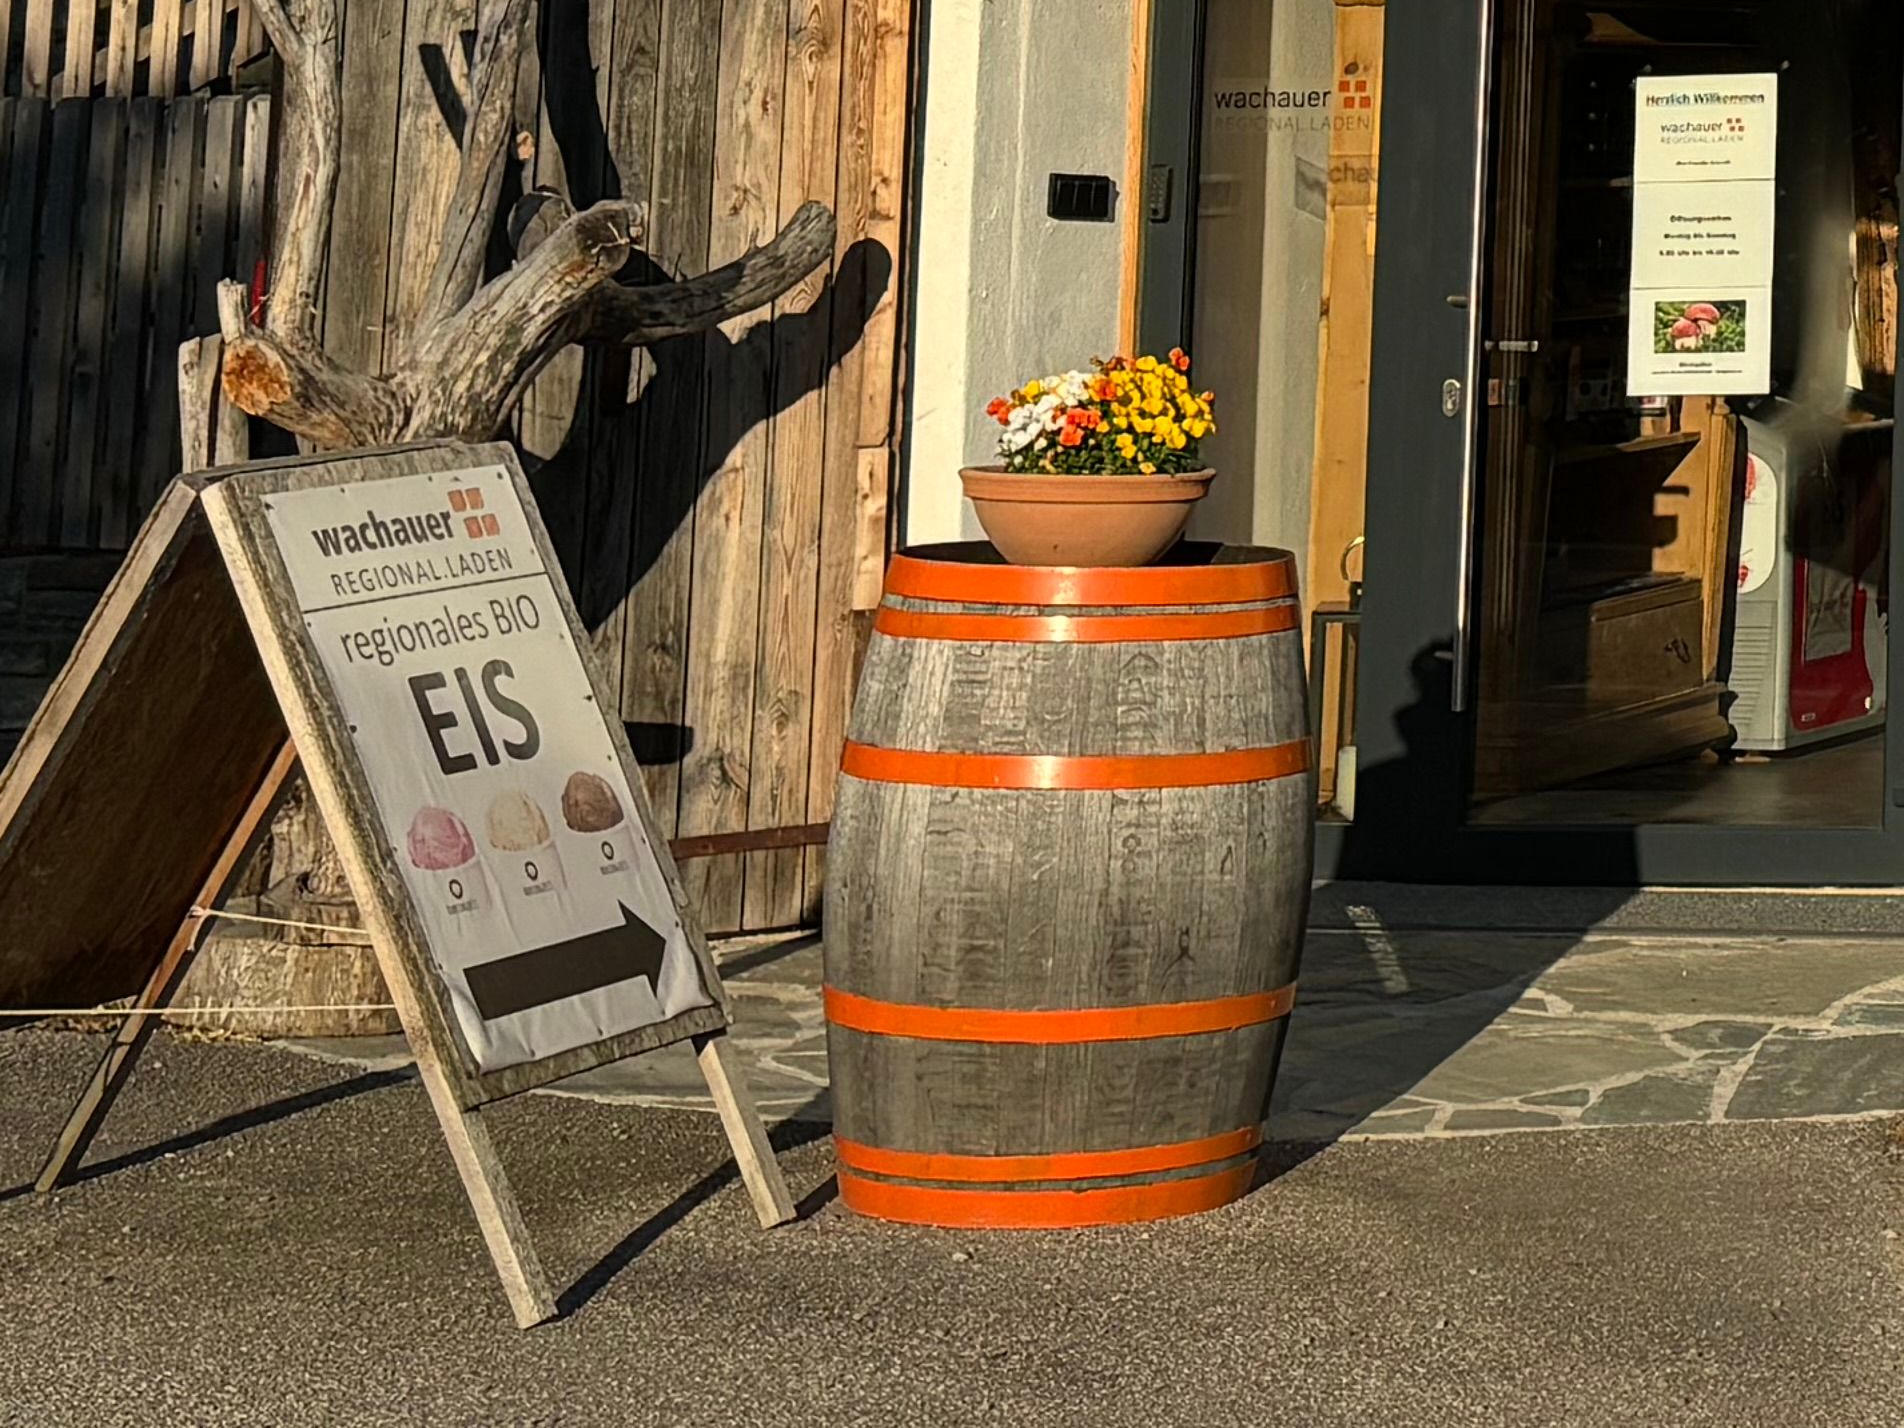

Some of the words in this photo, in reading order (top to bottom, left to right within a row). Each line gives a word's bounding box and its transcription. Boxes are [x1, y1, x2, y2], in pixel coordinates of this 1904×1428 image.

[1213, 85, 1332, 110] wachauer
[1645, 94, 1691, 107] Herzlich
[1693, 91, 1765, 105] Willkommen
[1660, 120, 1723, 134] wachauer
[311, 507, 457, 559] wachauer
[331, 547, 514, 598] REGIONAL.LADEN
[340, 606, 490, 668] regionales
[489, 594, 541, 639] BIO
[408, 657, 542, 776] EIS
